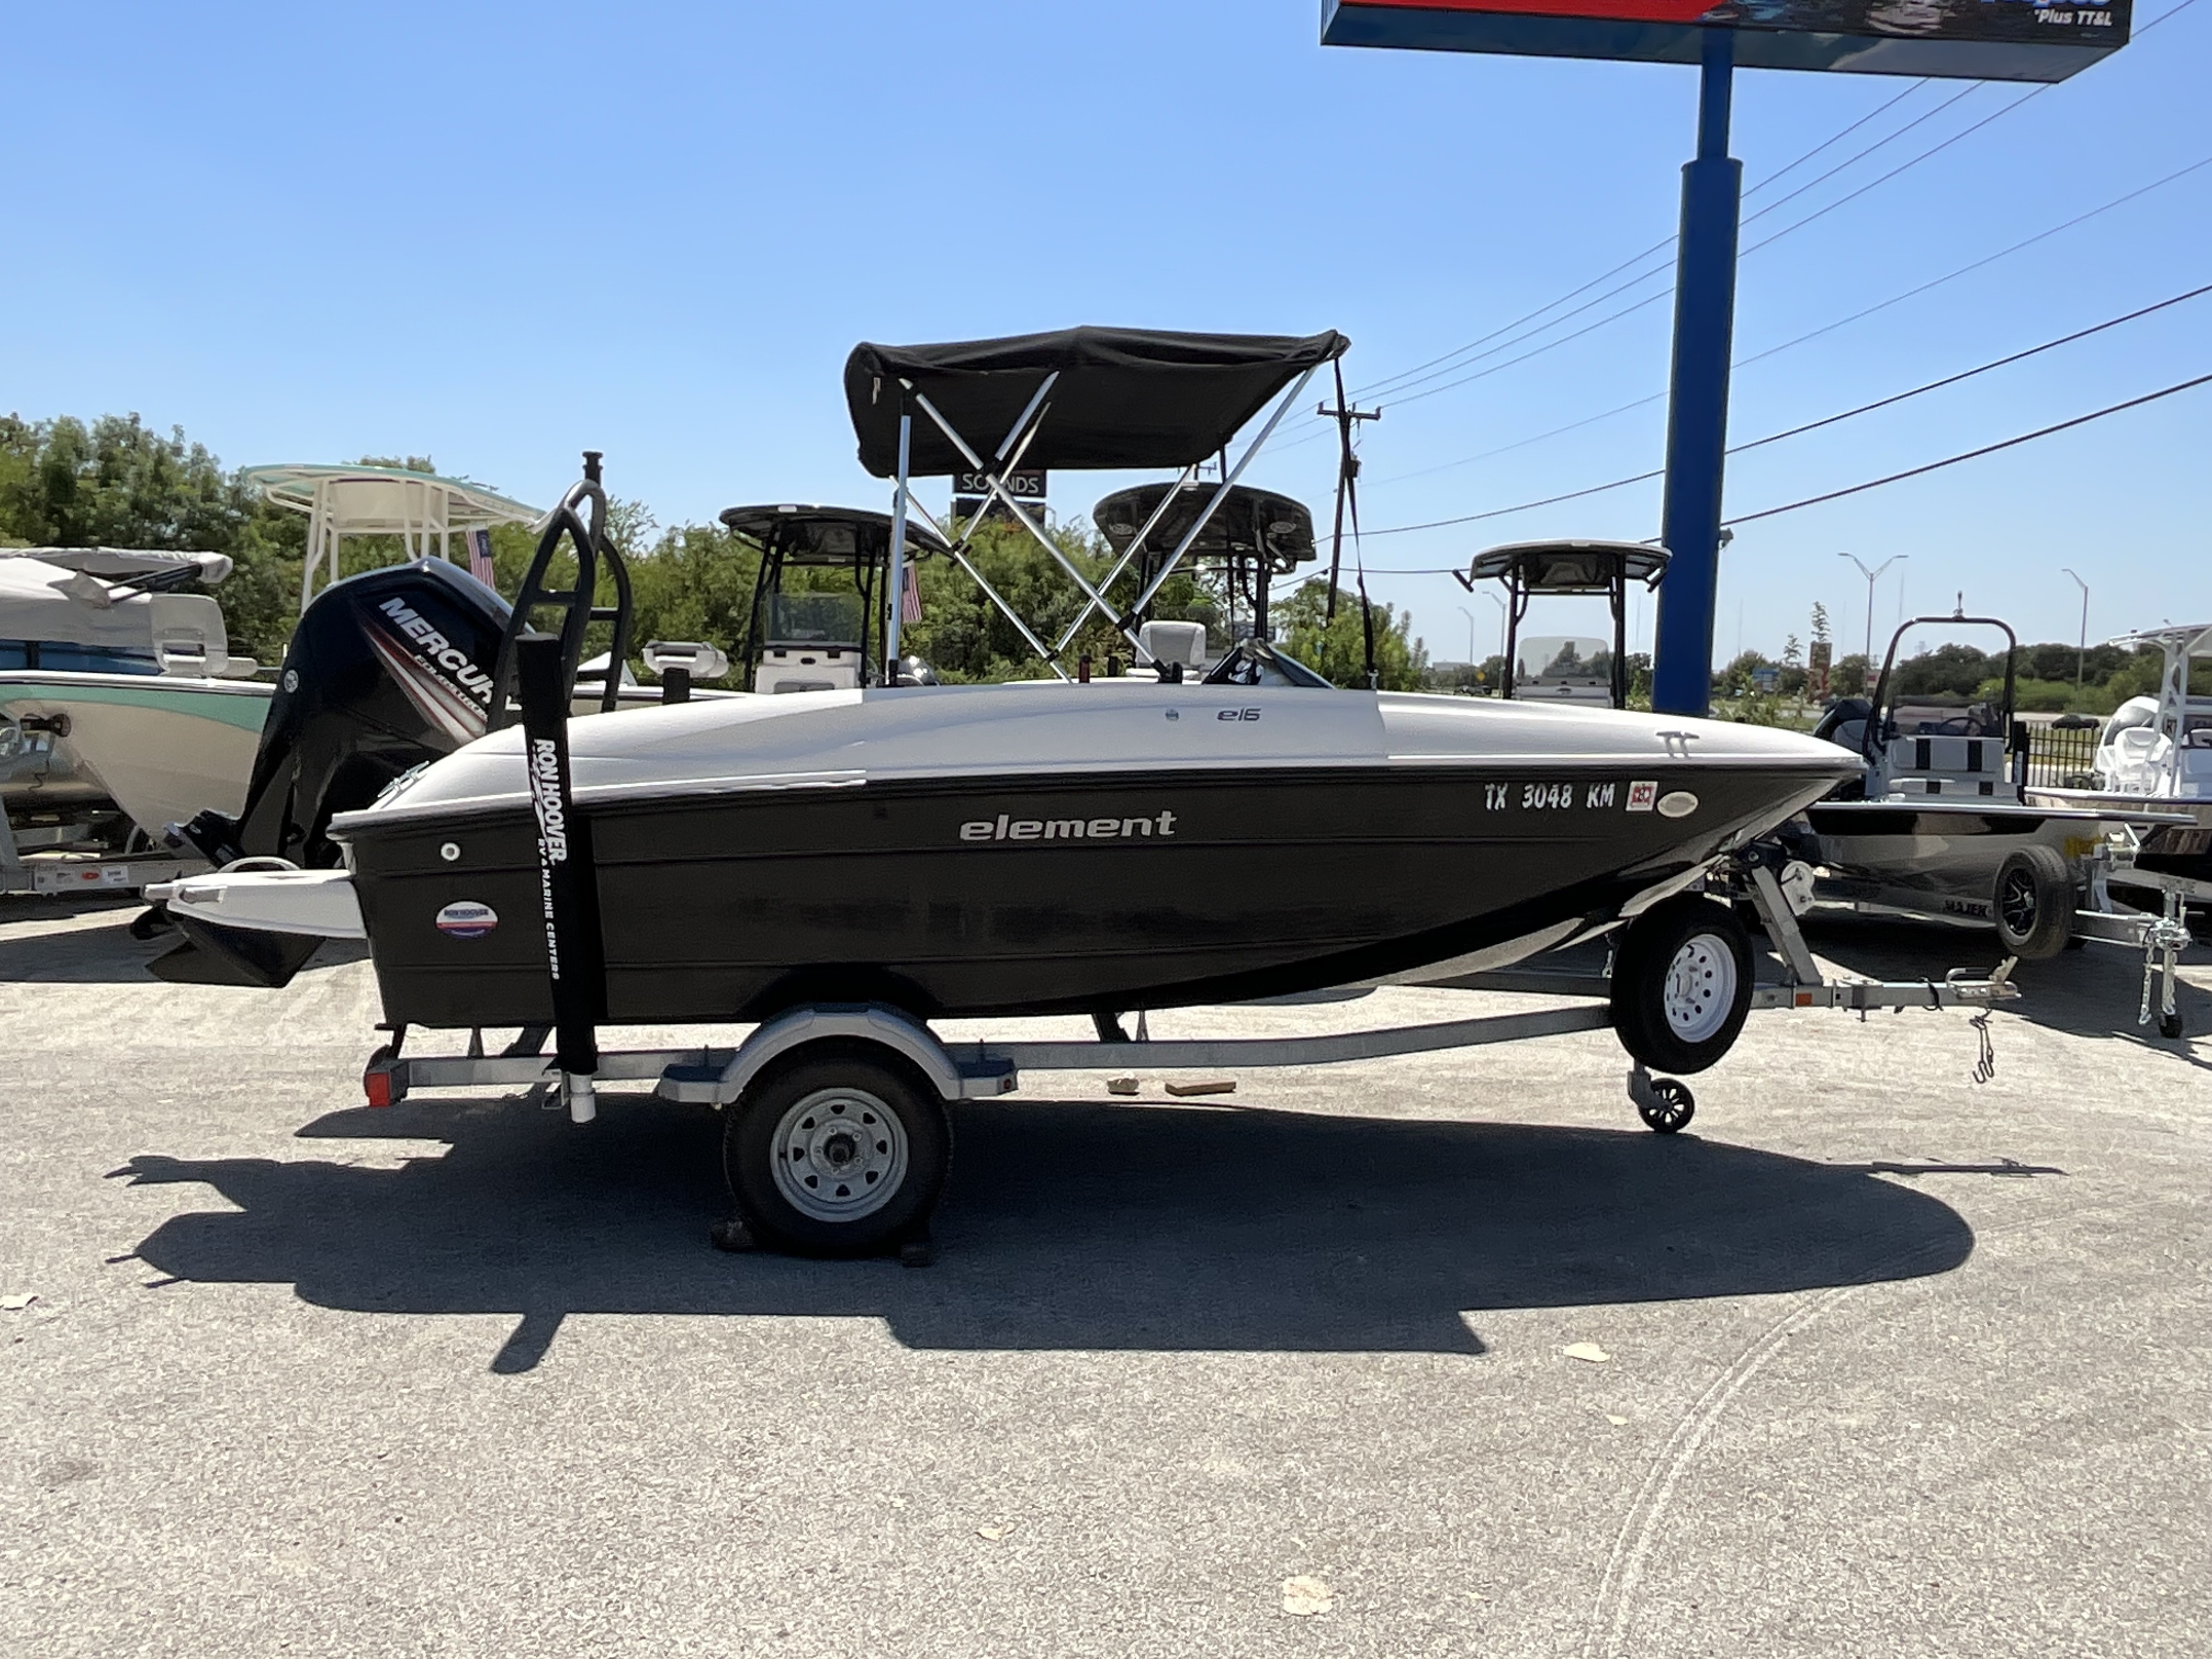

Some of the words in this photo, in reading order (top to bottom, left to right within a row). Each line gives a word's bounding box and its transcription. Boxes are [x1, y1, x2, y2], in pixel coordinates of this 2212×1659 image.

[2077, 10, 2112, 26] TT&L
[962, 473, 1039, 494] SONDS
[533, 740, 560, 781] RON
[1485, 783, 1509, 810] TX
[1522, 783, 1573, 809] 3048
[1586, 783, 1615, 809] KM
[541, 782, 567, 865] HOOVER
[960, 810, 1177, 840] element
